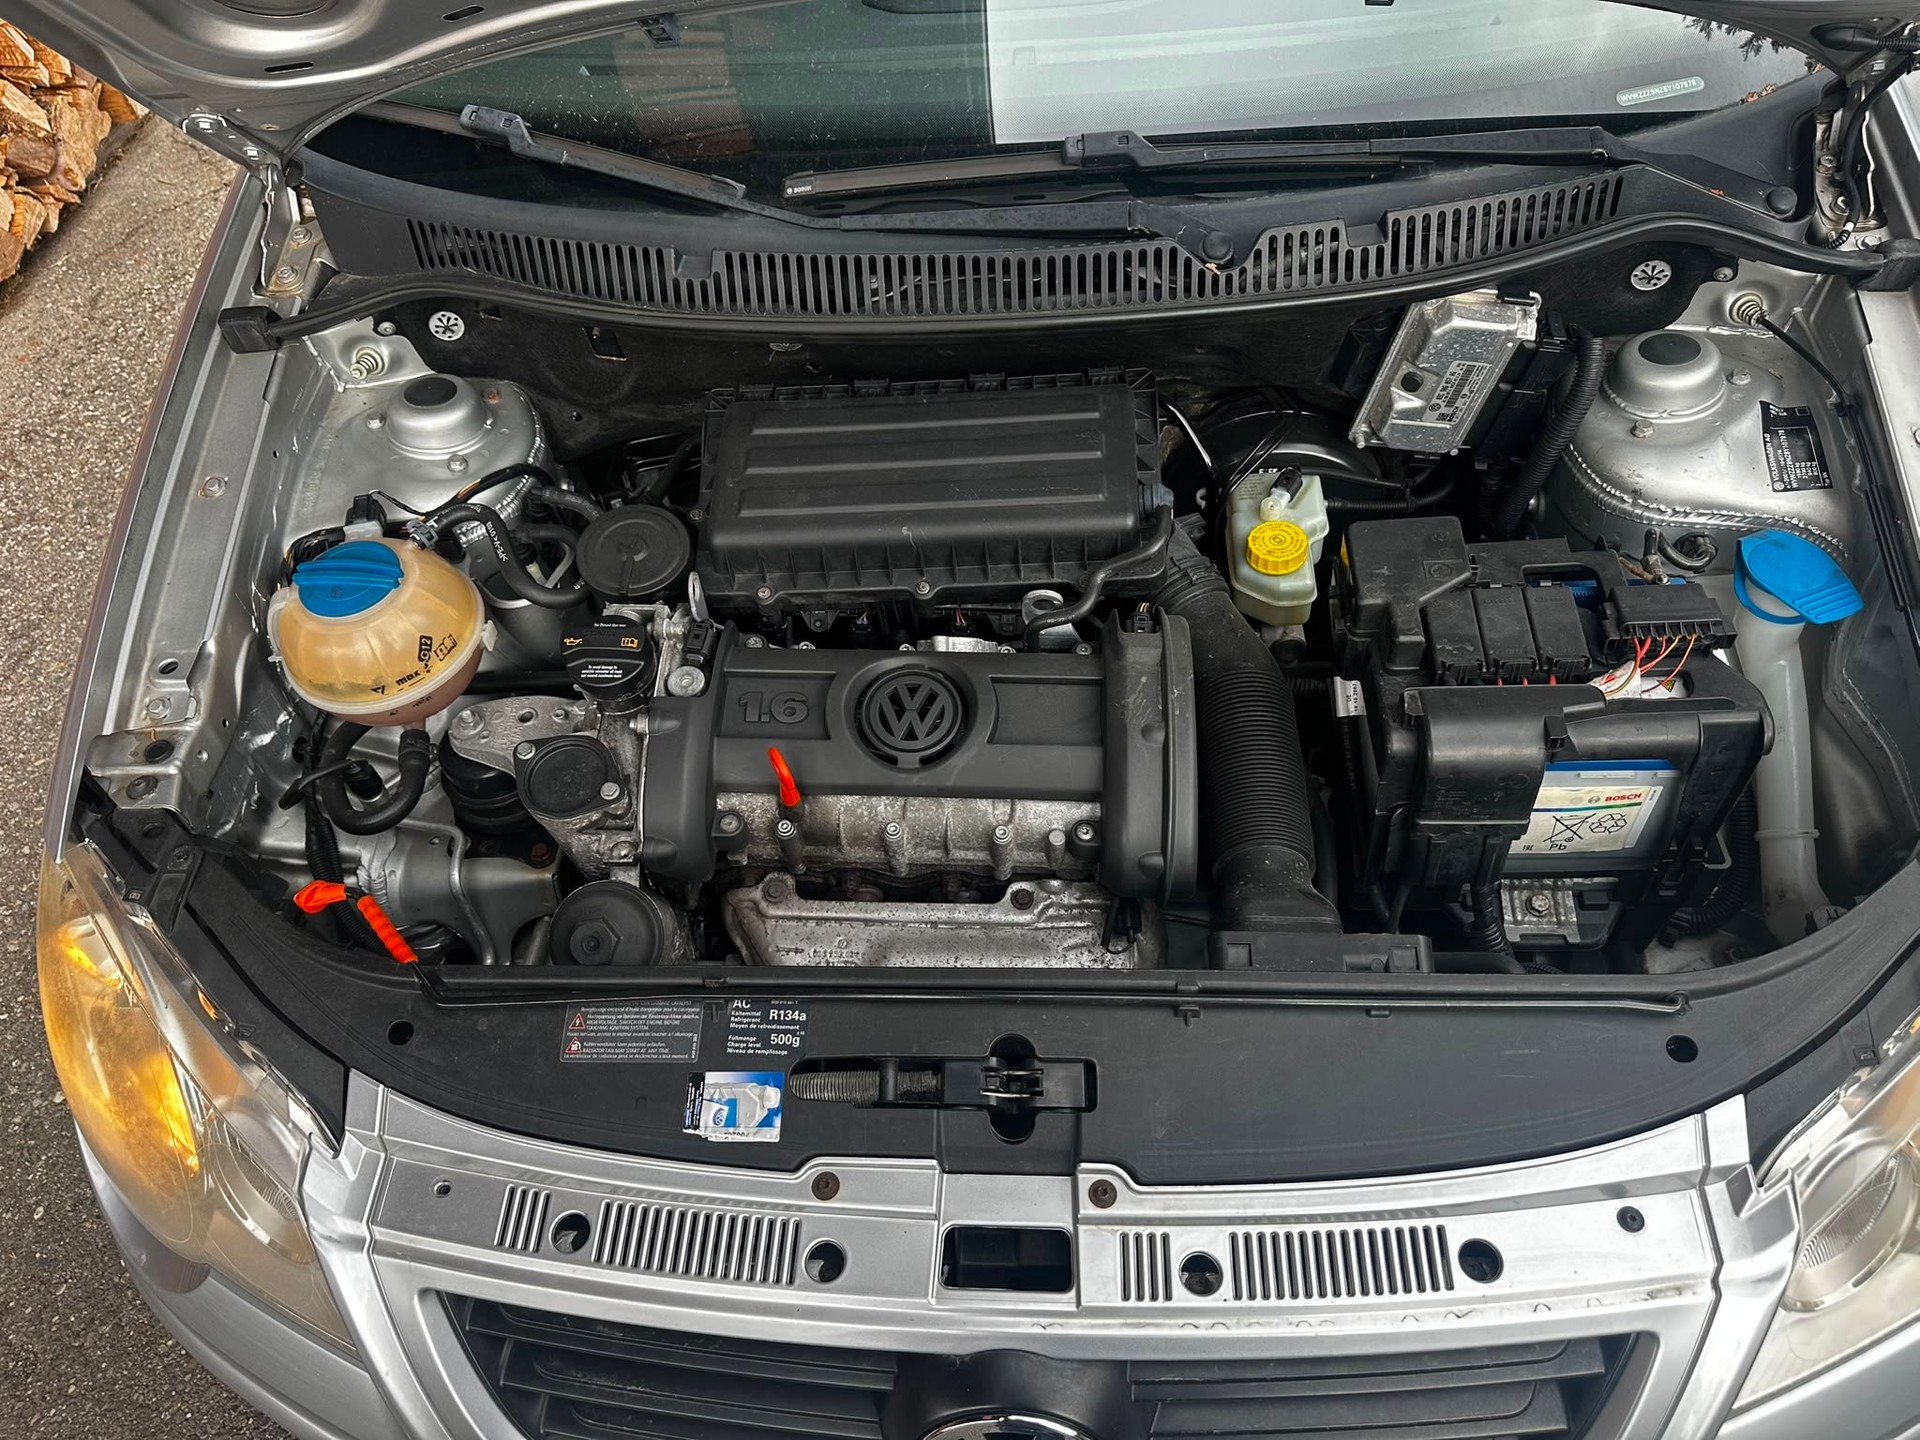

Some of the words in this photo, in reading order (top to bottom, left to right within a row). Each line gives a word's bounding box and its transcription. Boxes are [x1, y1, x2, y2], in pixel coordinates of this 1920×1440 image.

[1766, 443, 1779, 480] VOLKSWAGEN
[422, 638, 430, 662] G12
[396, 670, 421, 686] max
[739, 692, 809, 724] 1.6
[1605, 793, 1641, 802] BOSCH
[733, 1000, 751, 1008] AC
[769, 1009, 806, 1020] R134a
[770, 1034, 800, 1048] 500g
